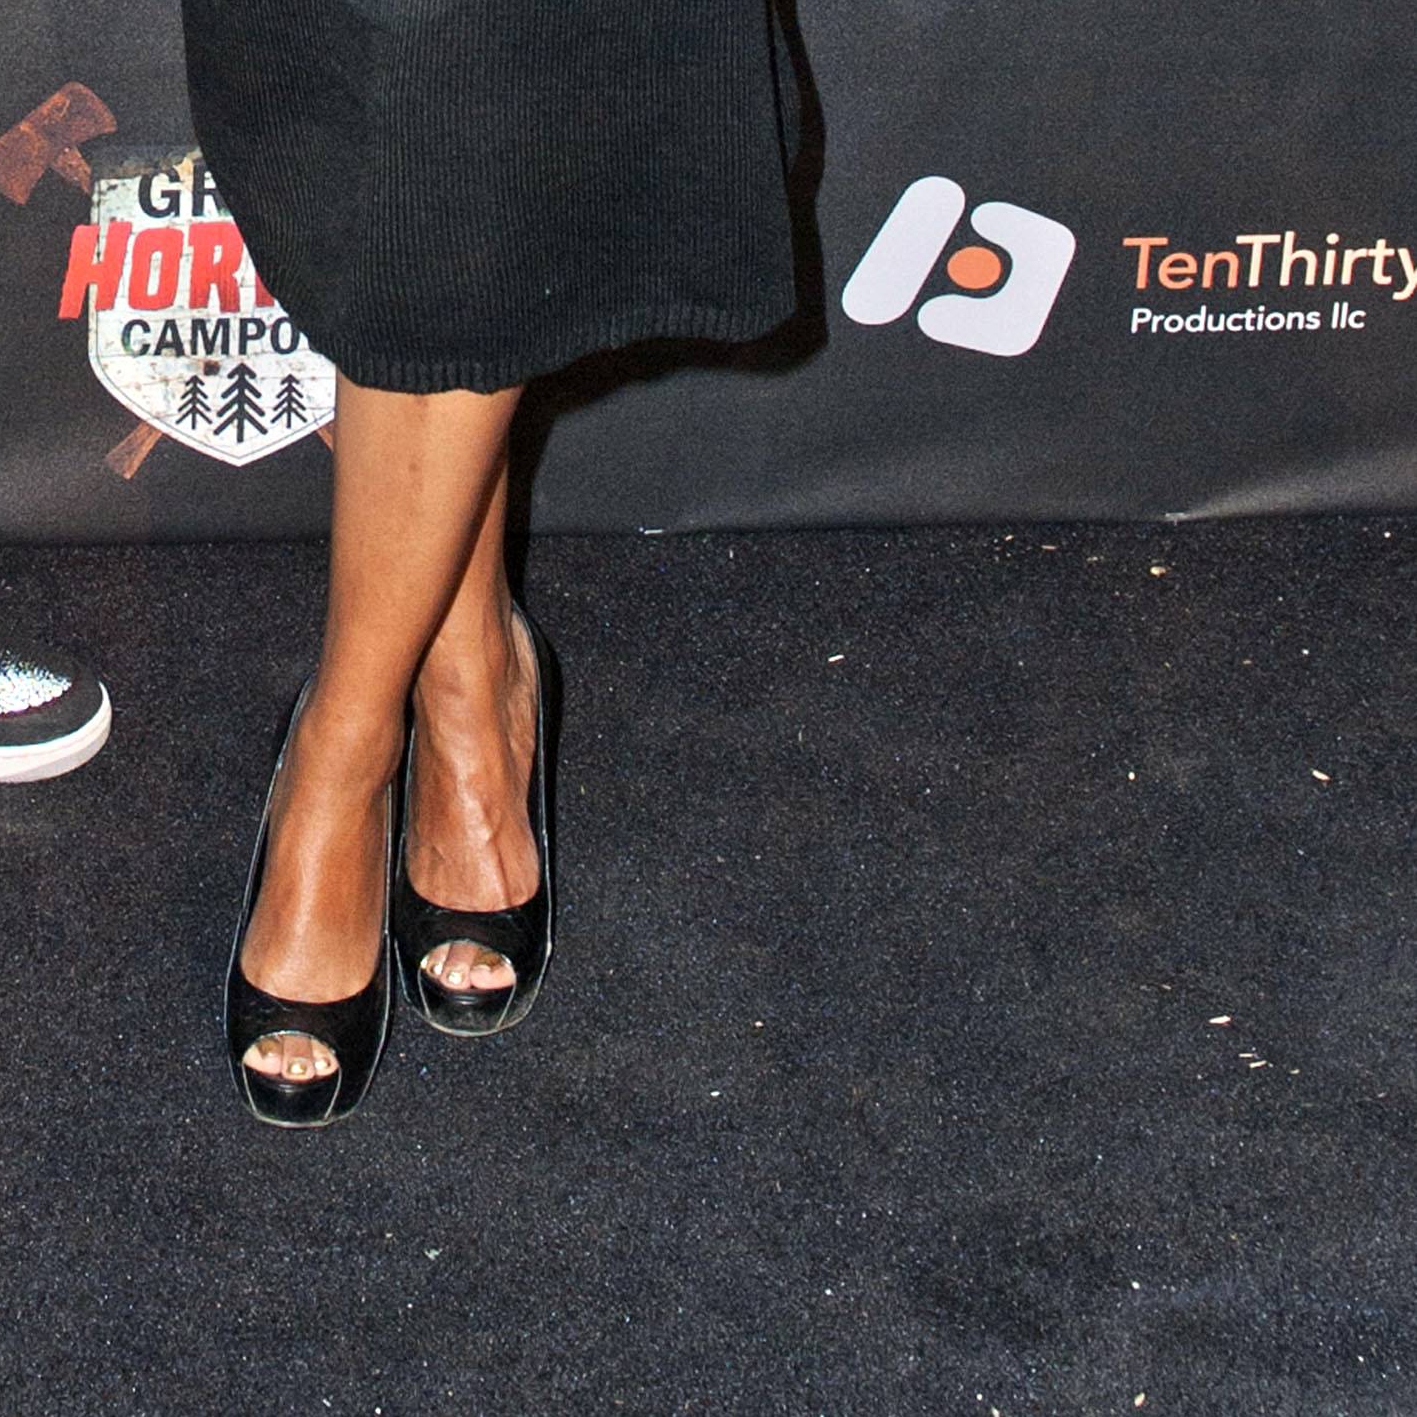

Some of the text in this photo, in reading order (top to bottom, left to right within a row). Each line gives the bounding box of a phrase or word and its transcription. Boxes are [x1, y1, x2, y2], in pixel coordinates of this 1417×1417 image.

[57, 221, 275, 320] HOR
[1130, 301, 1367, 334] Productions llc
